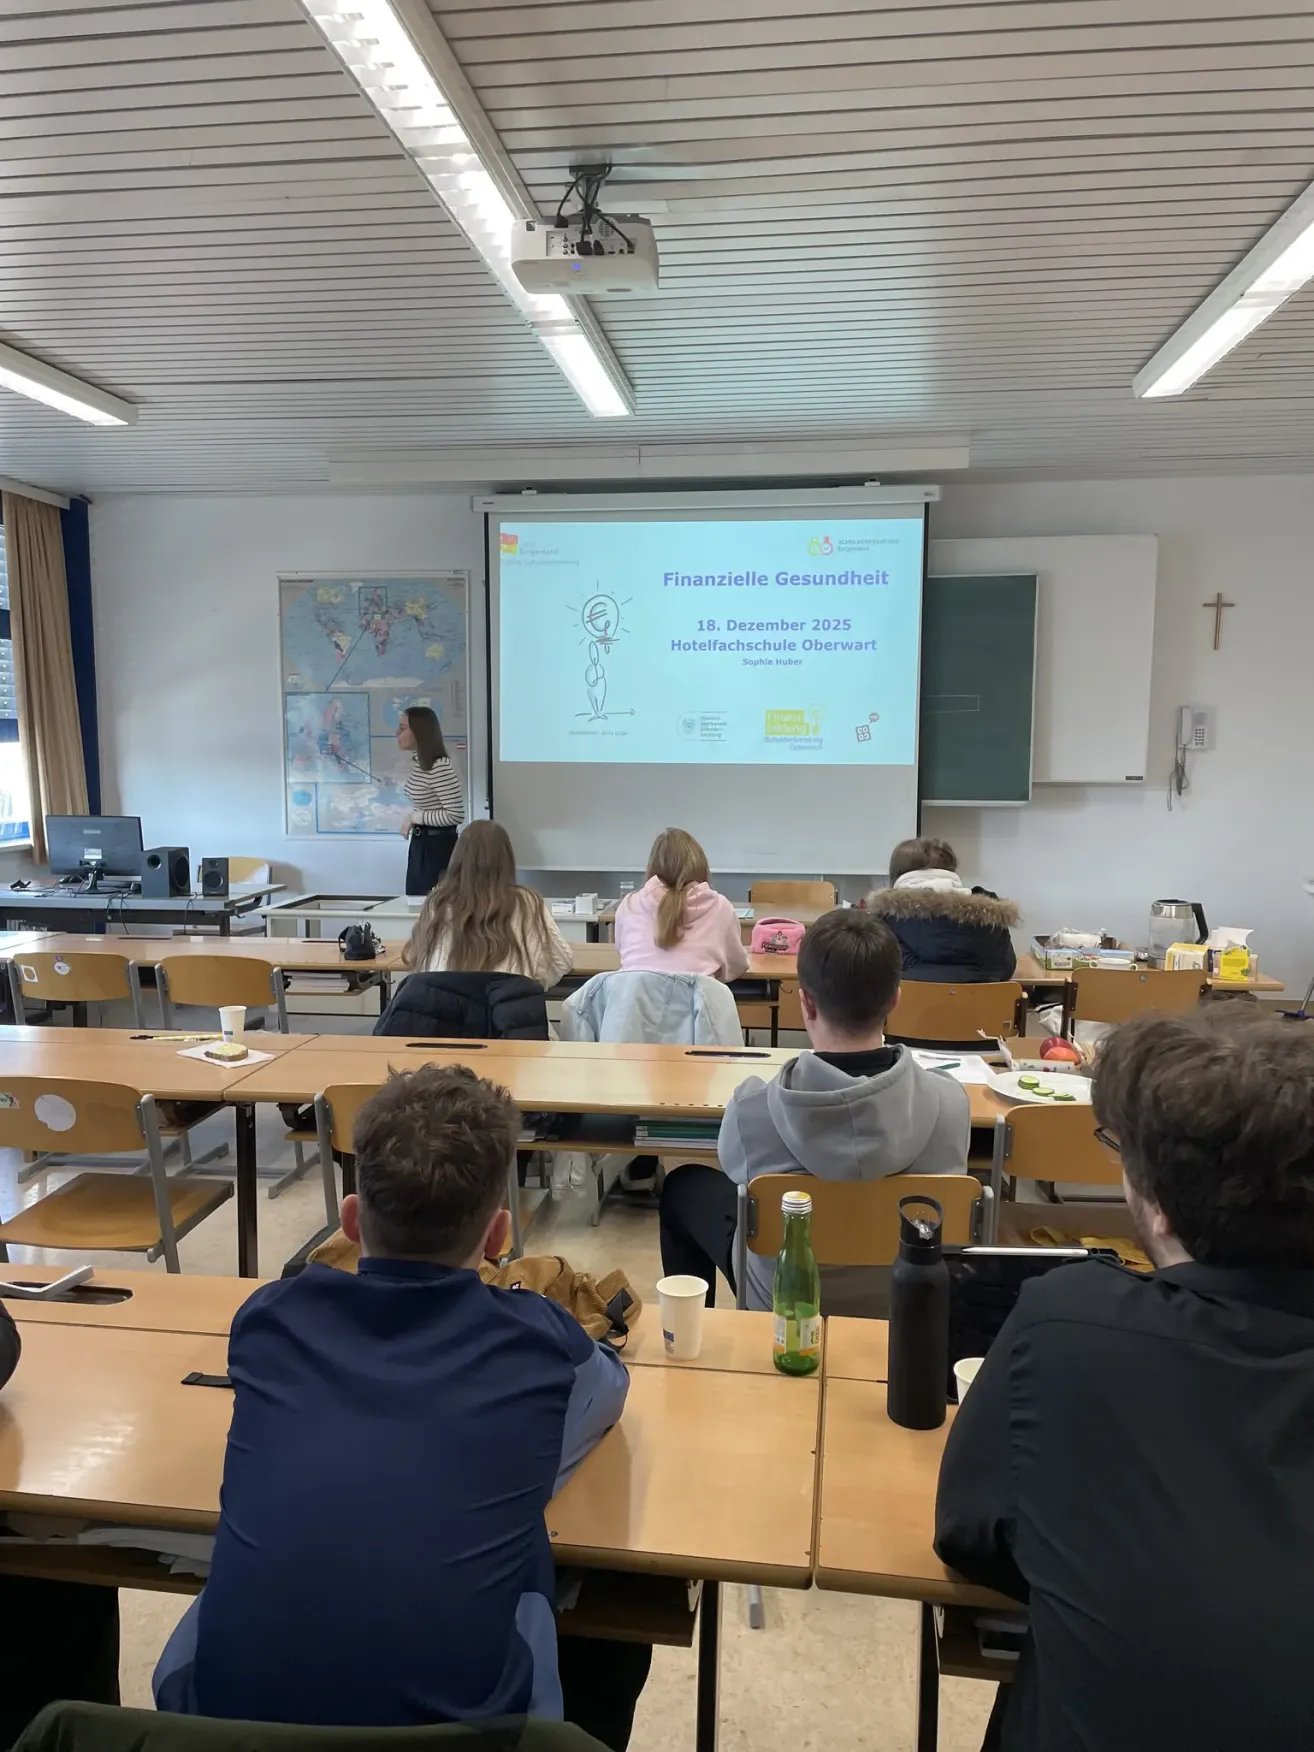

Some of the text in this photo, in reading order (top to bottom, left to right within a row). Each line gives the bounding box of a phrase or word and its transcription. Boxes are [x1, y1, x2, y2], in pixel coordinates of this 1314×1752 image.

[663, 570, 890, 587] Finanzielle Gesundheit
[697, 619, 852, 632] 18. Dezember 2025
[670, 638, 878, 652] Hotelfachschule Oberwart
[742, 657, 803, 667] Sophie Huber
